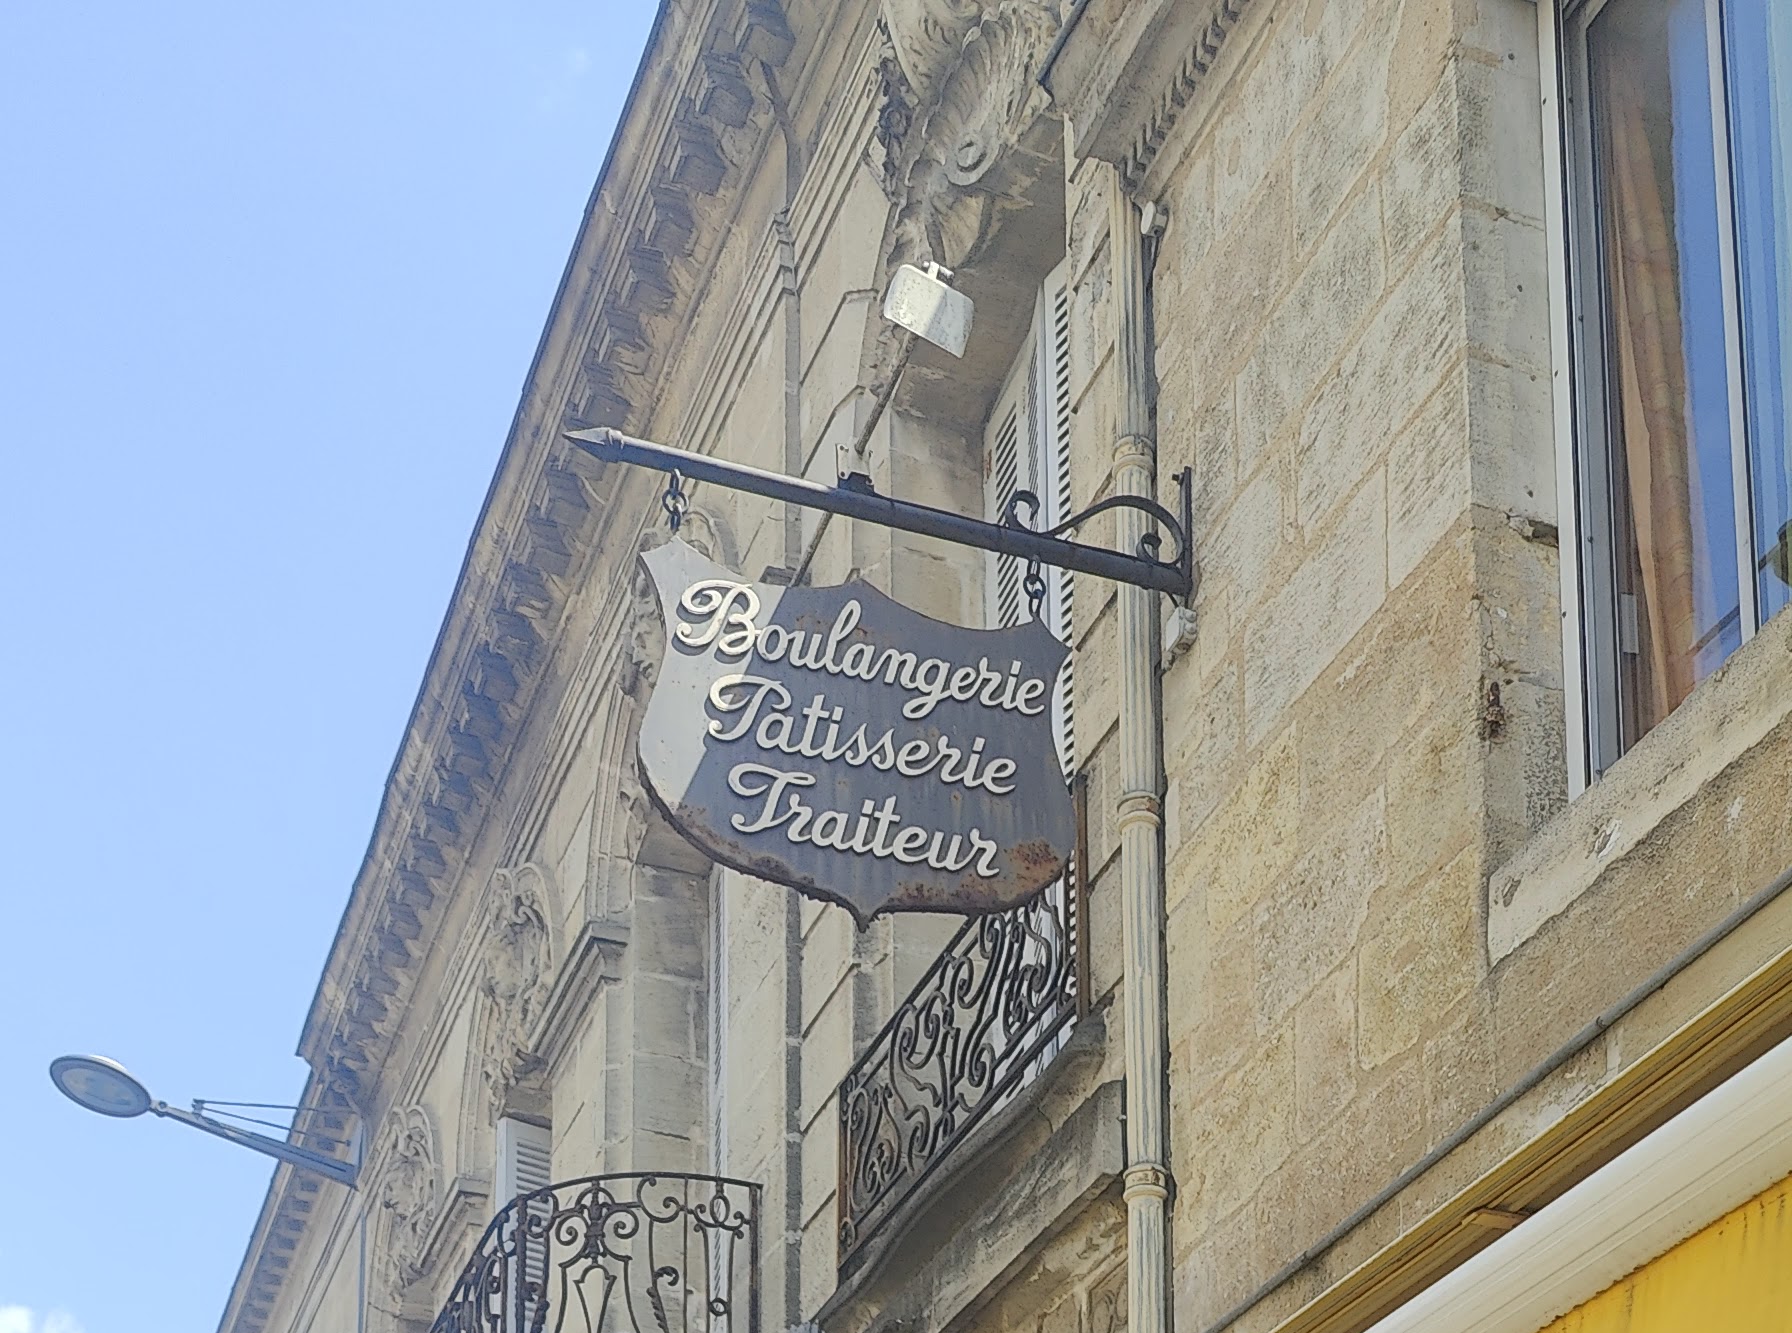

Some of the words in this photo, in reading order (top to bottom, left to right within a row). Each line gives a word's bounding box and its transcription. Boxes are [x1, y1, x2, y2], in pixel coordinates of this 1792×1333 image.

[676, 579, 1046, 720] Boulangerie
[708, 673, 1017, 794] Patisserie
[728, 762, 1000, 878] Traiteur
